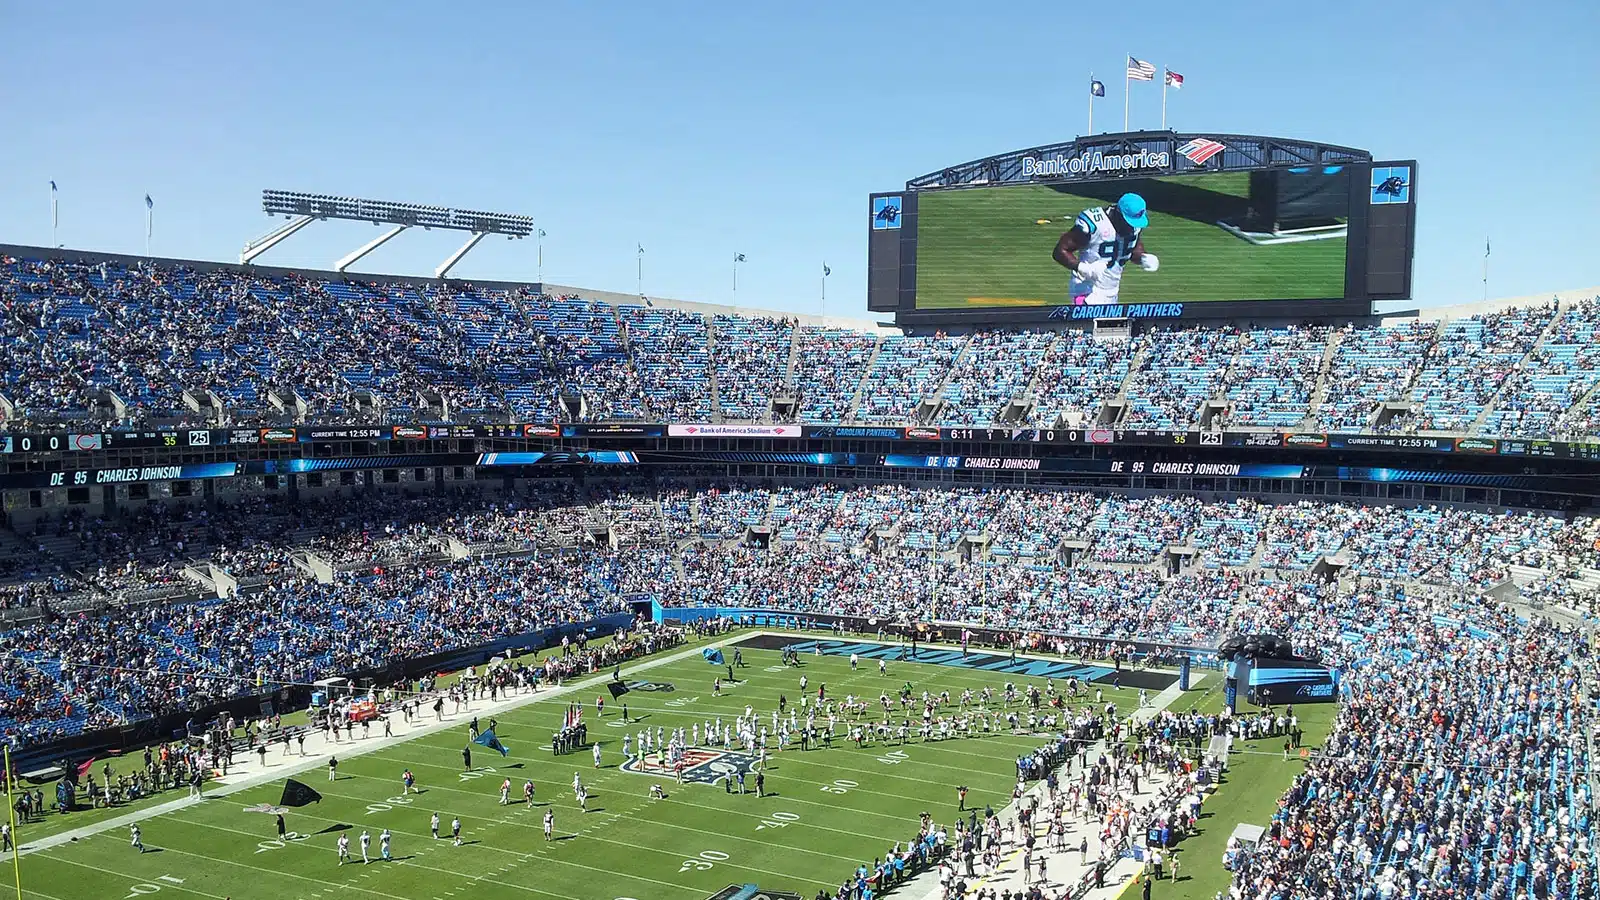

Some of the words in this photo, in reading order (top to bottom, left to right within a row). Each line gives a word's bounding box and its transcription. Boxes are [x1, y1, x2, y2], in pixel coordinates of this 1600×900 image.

[1022, 156, 1068, 176] Bank
[1069, 152, 1090, 172] of
[1091, 150, 1169, 171] America
[1072, 305, 1123, 319] CAROLINA
[1127, 304, 1183, 317] PANTHERS
[192, 432, 206, 444] 25
[349, 430, 368, 438] 12:55
[836, 428, 865, 436] CAROLINA
[866, 428, 896, 436] PANTHERS
[951, 430, 973, 439] 6:11
[1046, 431, 1054, 441] 0
[1070, 431, 1076, 441] 0
[22, 438, 31, 450] 0
[50, 437, 58, 450] 0
[164, 437, 176, 446] 35
[1174, 436, 1186, 444] 35
[1202, 433, 1218, 444] 25
[1398, 439, 1422, 447] 12:55
[1423, 440, 1438, 448] PM
[927, 456, 939, 467] DE
[947, 456, 958, 468] 95
[964, 458, 1000, 468] CHARLES
[1001, 458, 1040, 470] JOHNSON
[1110, 462, 1124, 472] DE
[1132, 462, 1144, 473] 95
[1152, 462, 1193, 474] CHARLES
[1194, 463, 1240, 476] JOHNSON
[50, 472, 64, 486] DE
[74, 471, 87, 485] 95
[96, 468, 138, 483] CHARLES
[139, 466, 181, 480] JOHNSON
[877, 750, 909, 765] 40
[820, 779, 859, 794] 50
[760, 811, 800, 829] 40
[682, 850, 730, 870] 30
[130, 873, 185, 894] 10
